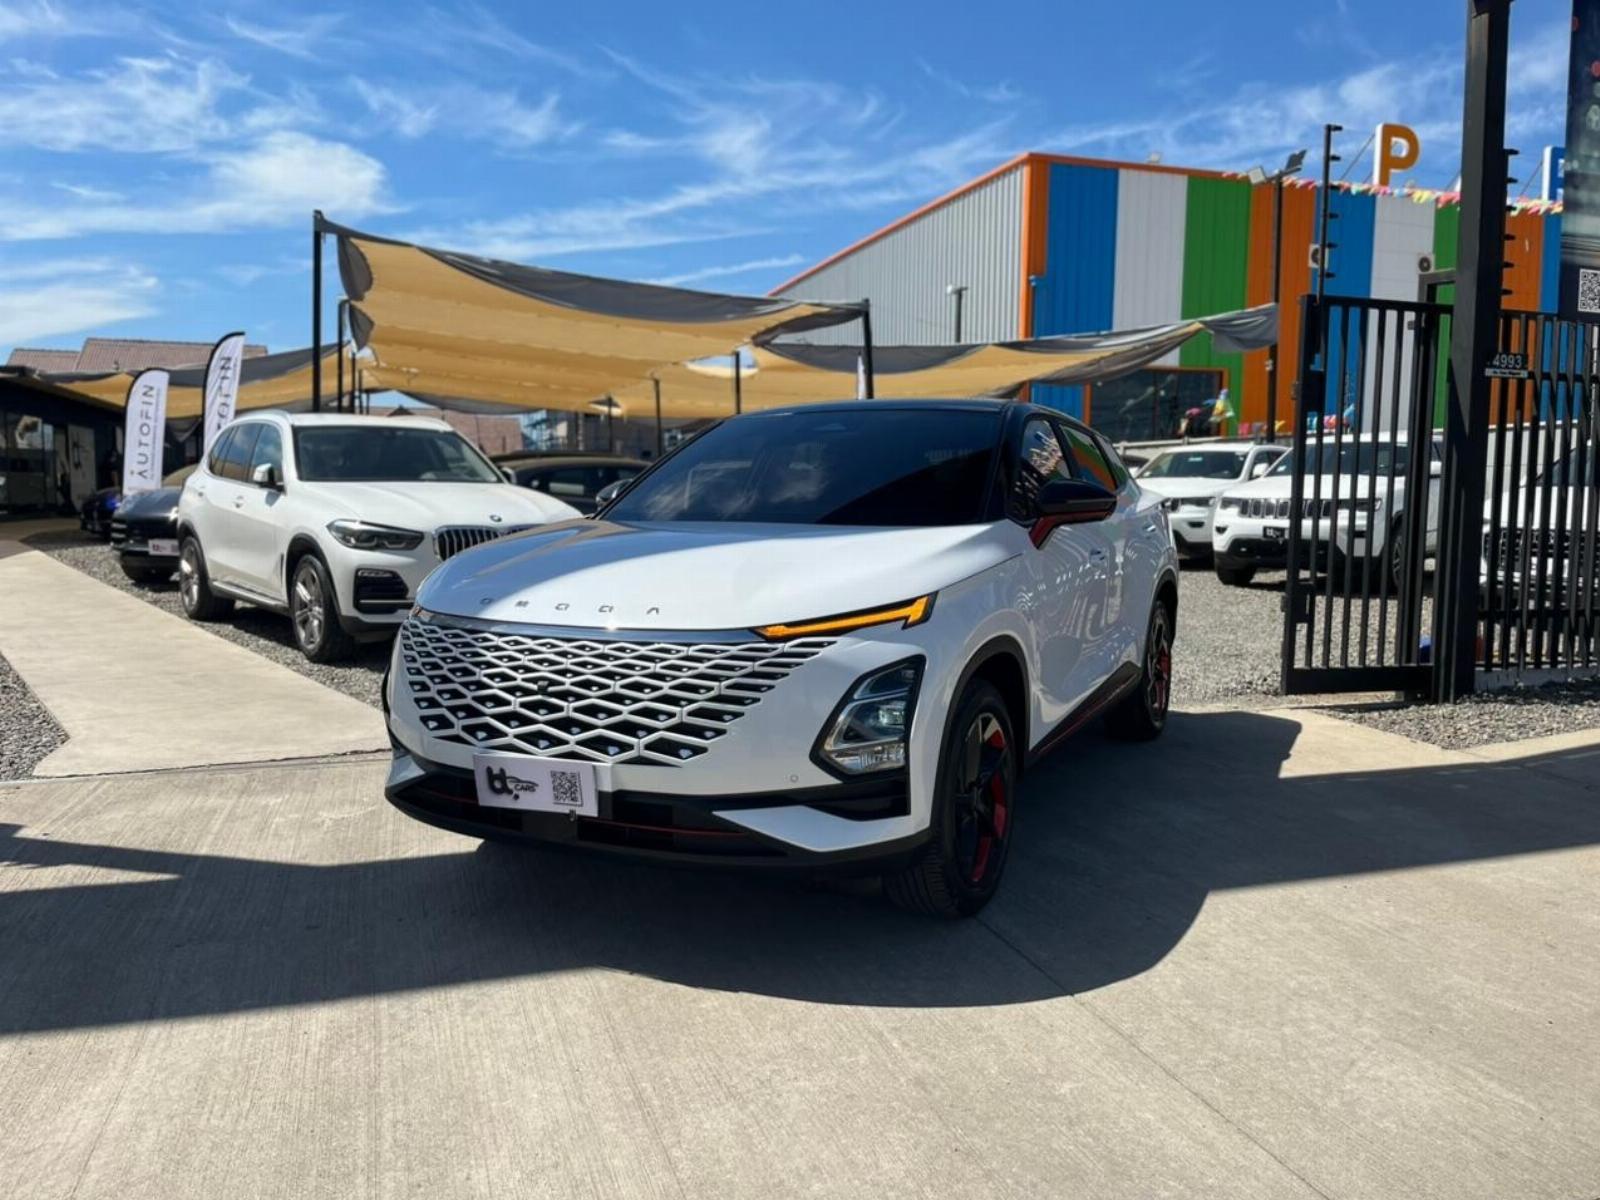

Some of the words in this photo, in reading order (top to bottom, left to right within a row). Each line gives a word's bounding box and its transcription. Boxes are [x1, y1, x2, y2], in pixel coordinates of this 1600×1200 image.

[1492, 353, 1522, 368] 4993
[136, 384, 155, 480] AUTOFIN
[514, 783, 537, 793] CARS
